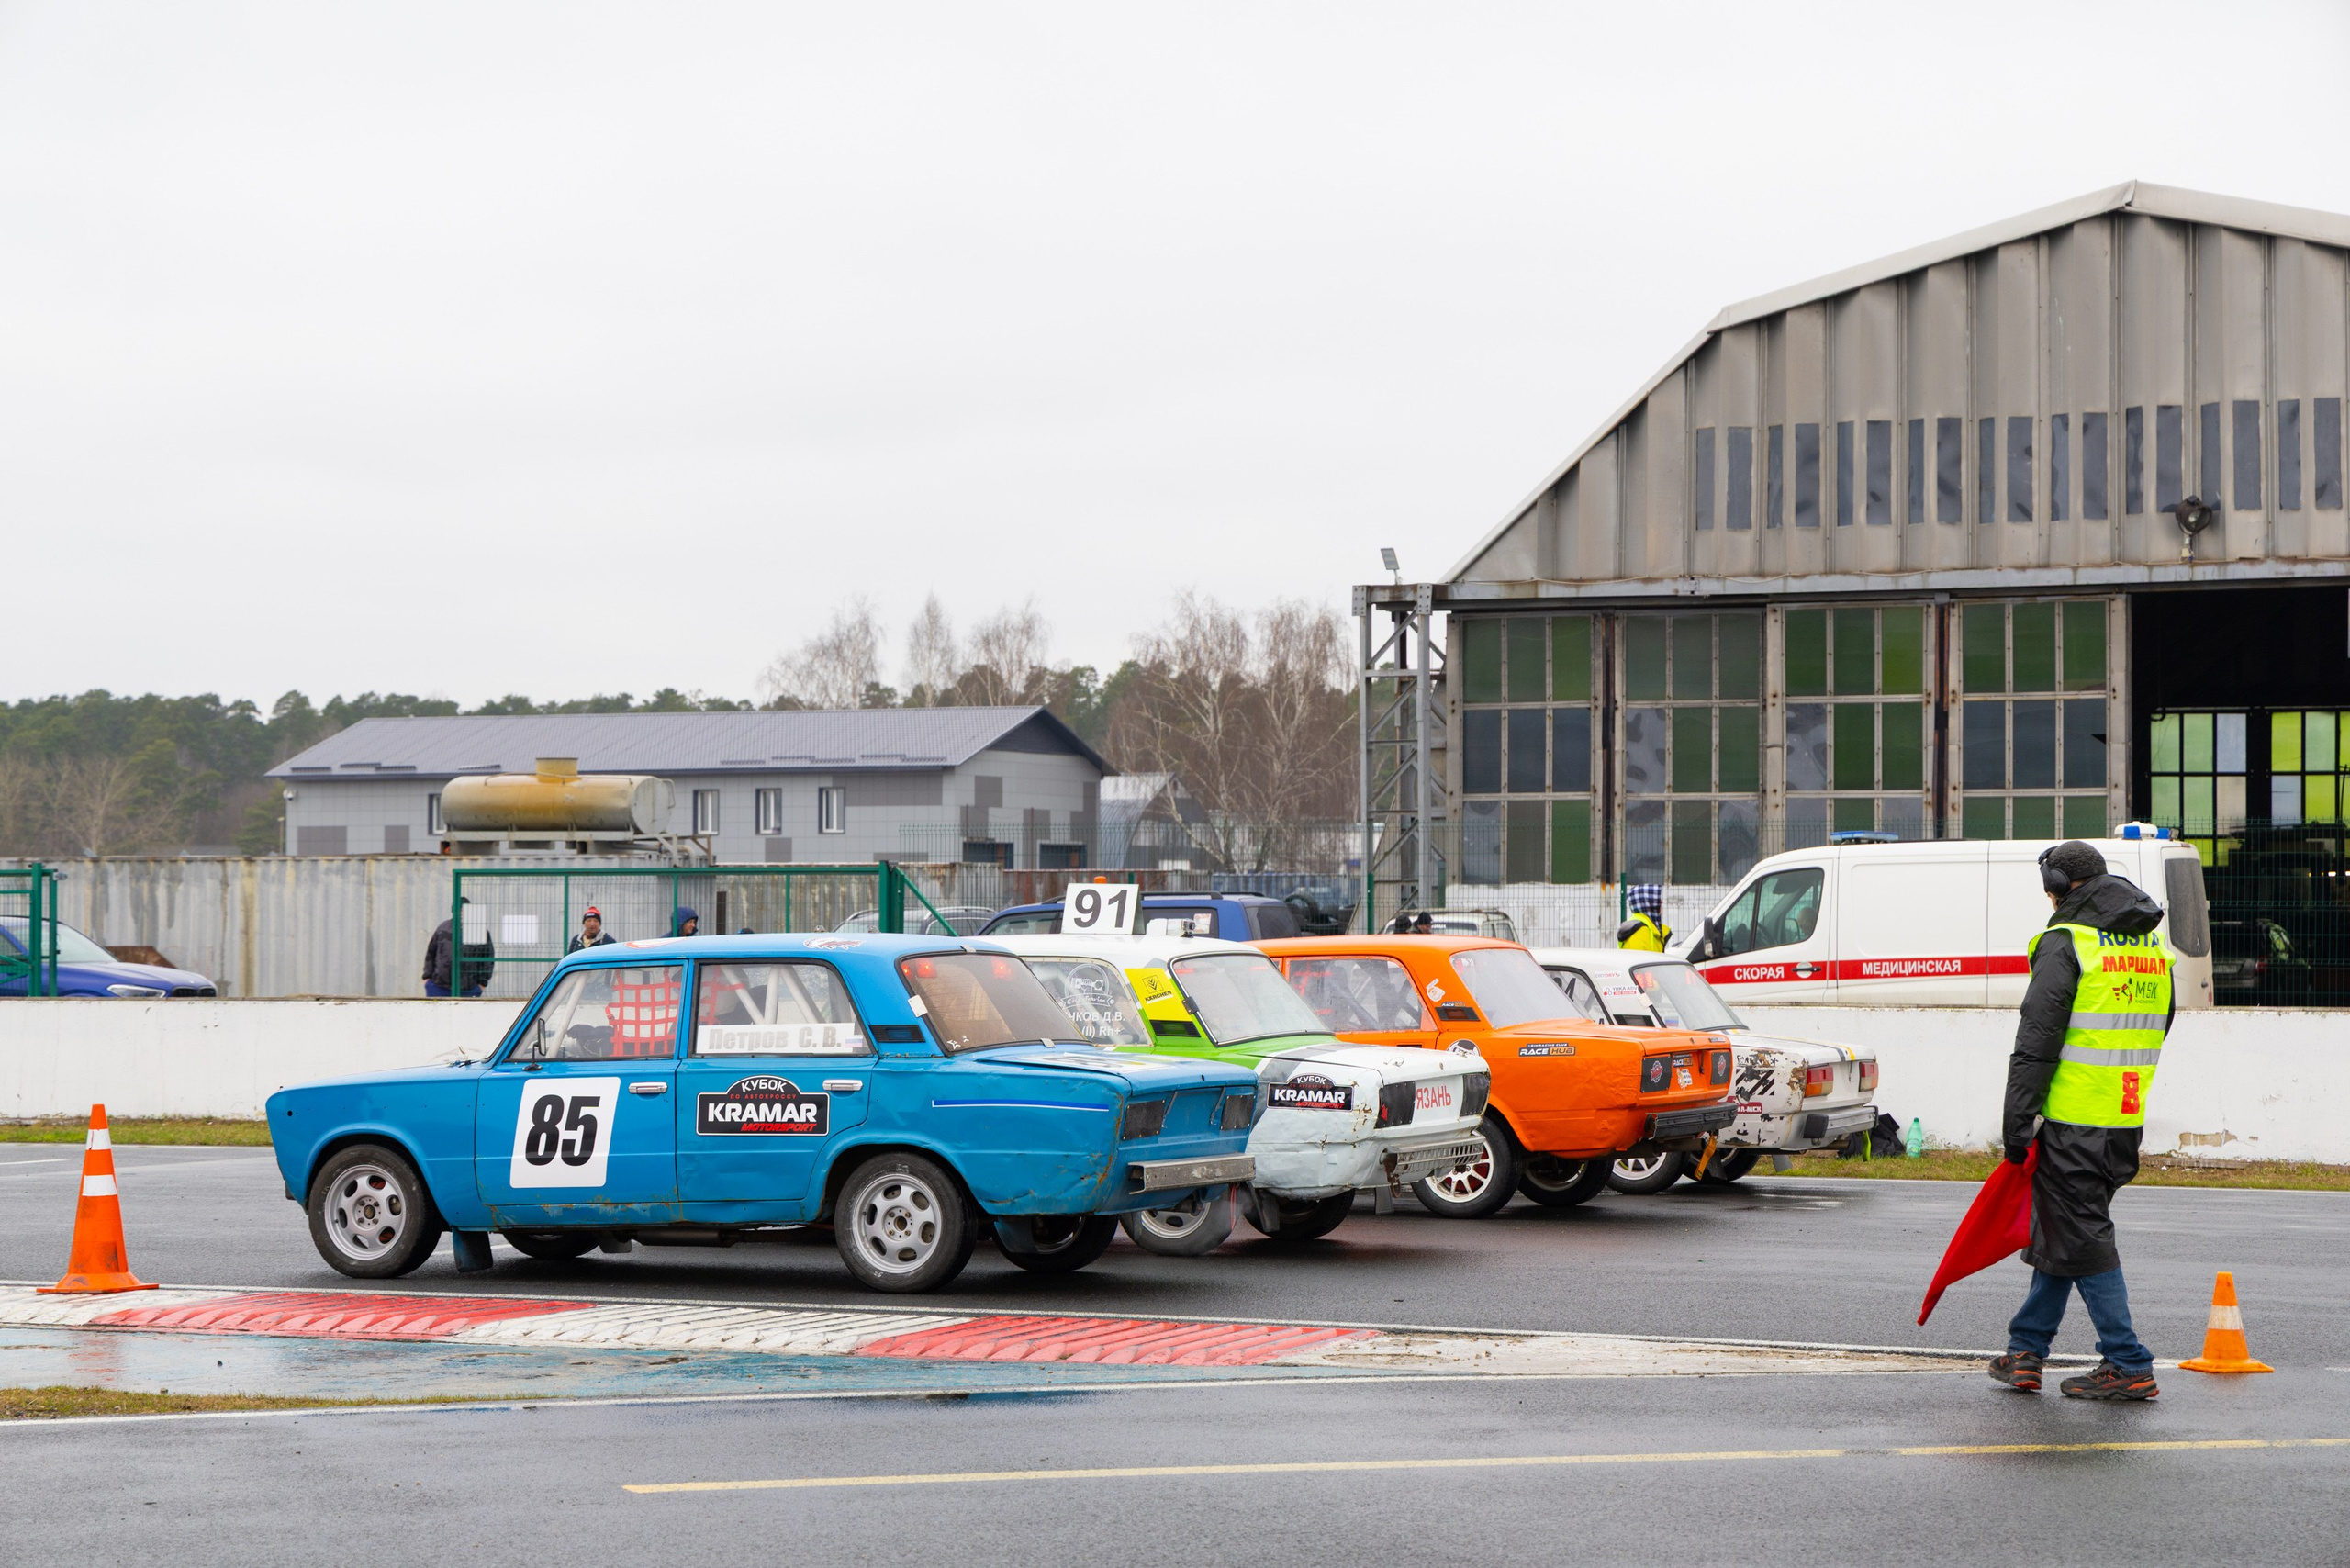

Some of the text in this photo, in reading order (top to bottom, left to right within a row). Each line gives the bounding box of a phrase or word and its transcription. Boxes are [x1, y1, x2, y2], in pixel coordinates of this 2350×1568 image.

[1073, 889, 1128, 928] 91
[1734, 959, 1962, 980] СКОРАЯ МЕДИЦИНСКАЯ
[2102, 956, 2166, 975] МАРШАЛ
[2135, 980, 2158, 999] MSK
[1102, 1011, 1125, 1024] Д.В.
[708, 1025, 842, 1051] Петров С. В.
[1099, 1026, 1121, 1036] Rh+
[1520, 1047, 1549, 1056] RACE
[741, 1079, 788, 1092] КУБОК
[1297, 1075, 1327, 1084] КУБОК
[1274, 1089, 1346, 1103] KRAMAR
[2121, 1071, 2140, 1114] 8
[708, 1103, 818, 1123] KRAMAR
[1296, 1101, 1346, 1109] MOTORSPORT
[525, 1094, 601, 1166] 85
[740, 1122, 818, 1132] MOTORSPORT
